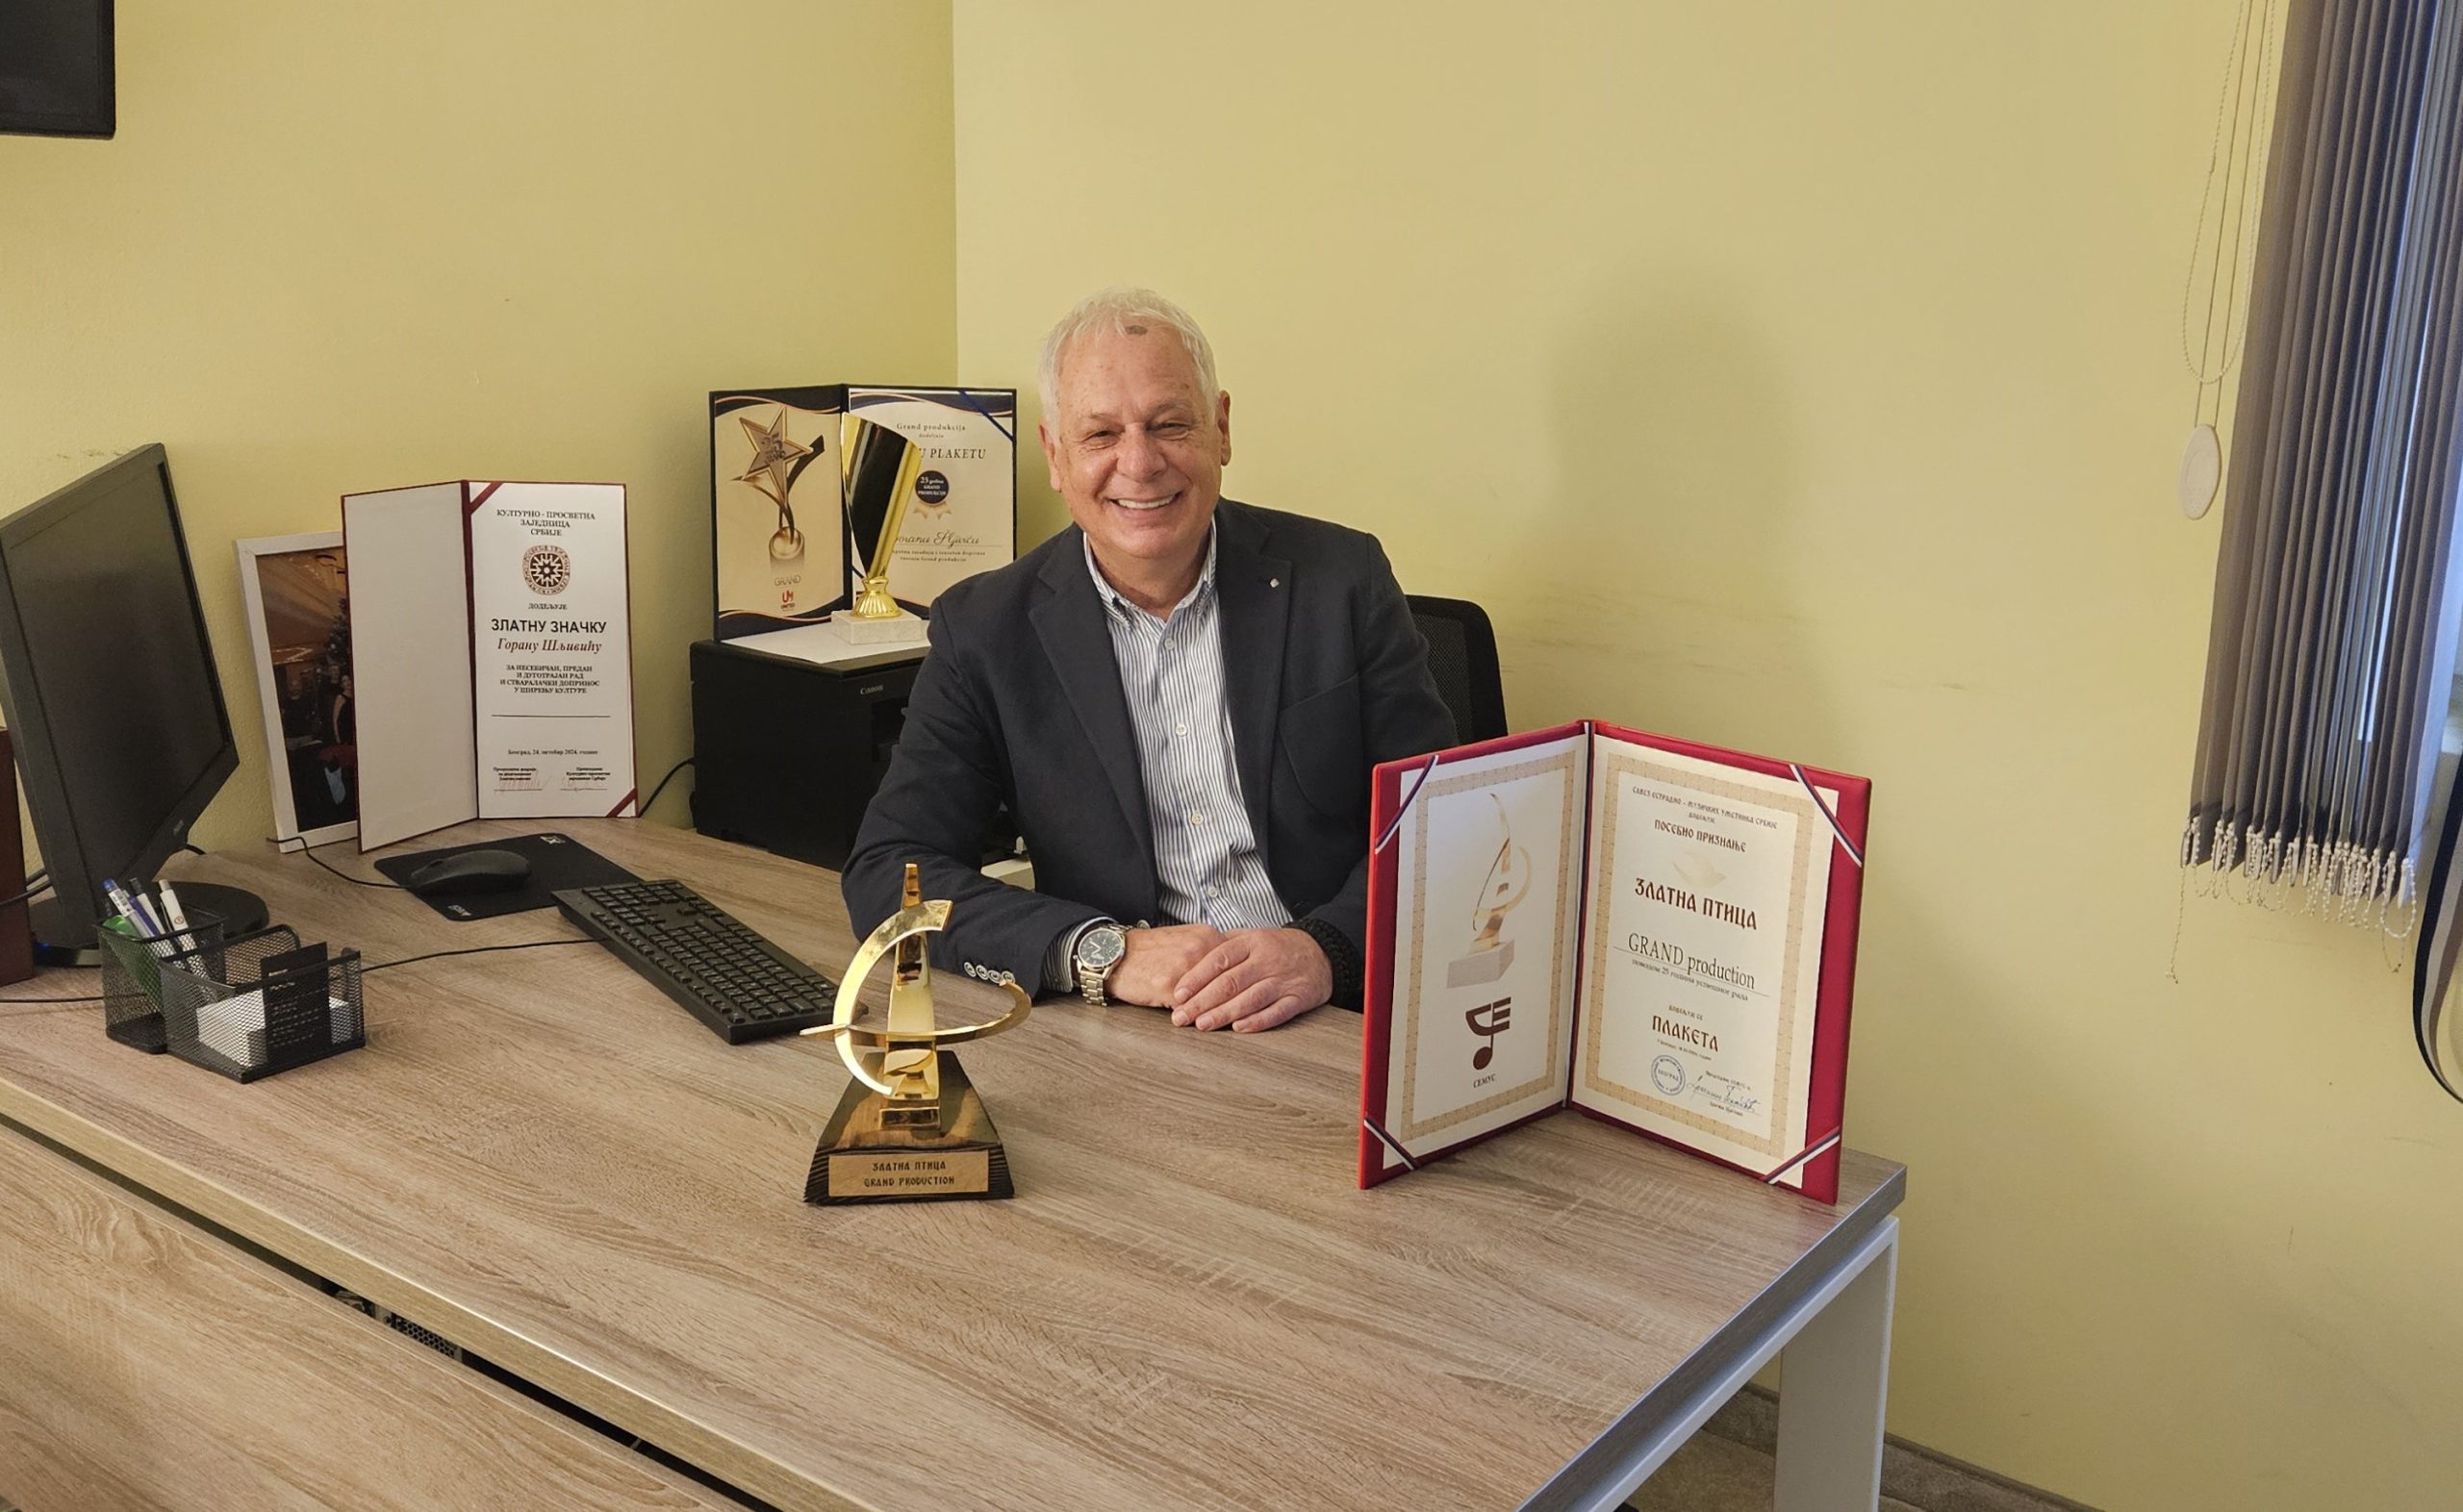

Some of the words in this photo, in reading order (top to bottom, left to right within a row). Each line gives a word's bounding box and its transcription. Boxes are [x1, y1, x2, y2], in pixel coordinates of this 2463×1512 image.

[930, 448, 986, 459] PLAKETU
[496, 509, 541, 517] КУЛТУРНО
[546, 511, 596, 520] ПРОСВЕТНА
[521, 519, 571, 528] ЗАЈЕДНИЦА
[896, 535, 930, 543] oranu
[491, 618, 546, 632] ЗЛАТНУ
[550, 620, 607, 634] ЗНАЧКУ
[497, 638, 539, 653] Горану
[542, 639, 602, 654] Шљивићу
[1633, 786, 1650, 796] САВЕЗ
[1652, 793, 1682, 804] ЕСТРАДНО
[1755, 818, 1778, 829] СРБИЈЕ
[1654, 819, 1694, 839] ПОСЕБНО
[1696, 830, 1746, 852] ПРИЗНАЊЕ
[1635, 877, 1697, 912] ЗЛАТНА
[1702, 897, 1758, 930] ПТИЦА
[1628, 933, 1684, 965] GRAND
[1687, 957, 1756, 990] production
[1662, 967, 1669, 975] 25
[1652, 1015, 1719, 1052] ПЛАКЕТА
[1473, 1073, 1496, 1088] СЕМУС
[872, 1161, 910, 1172] ЗЛАТНА
[914, 1160, 947, 1171] ПТИЦА
[864, 1177, 895, 1187] GRAND
[899, 1176, 954, 1186] PRODUCTION
